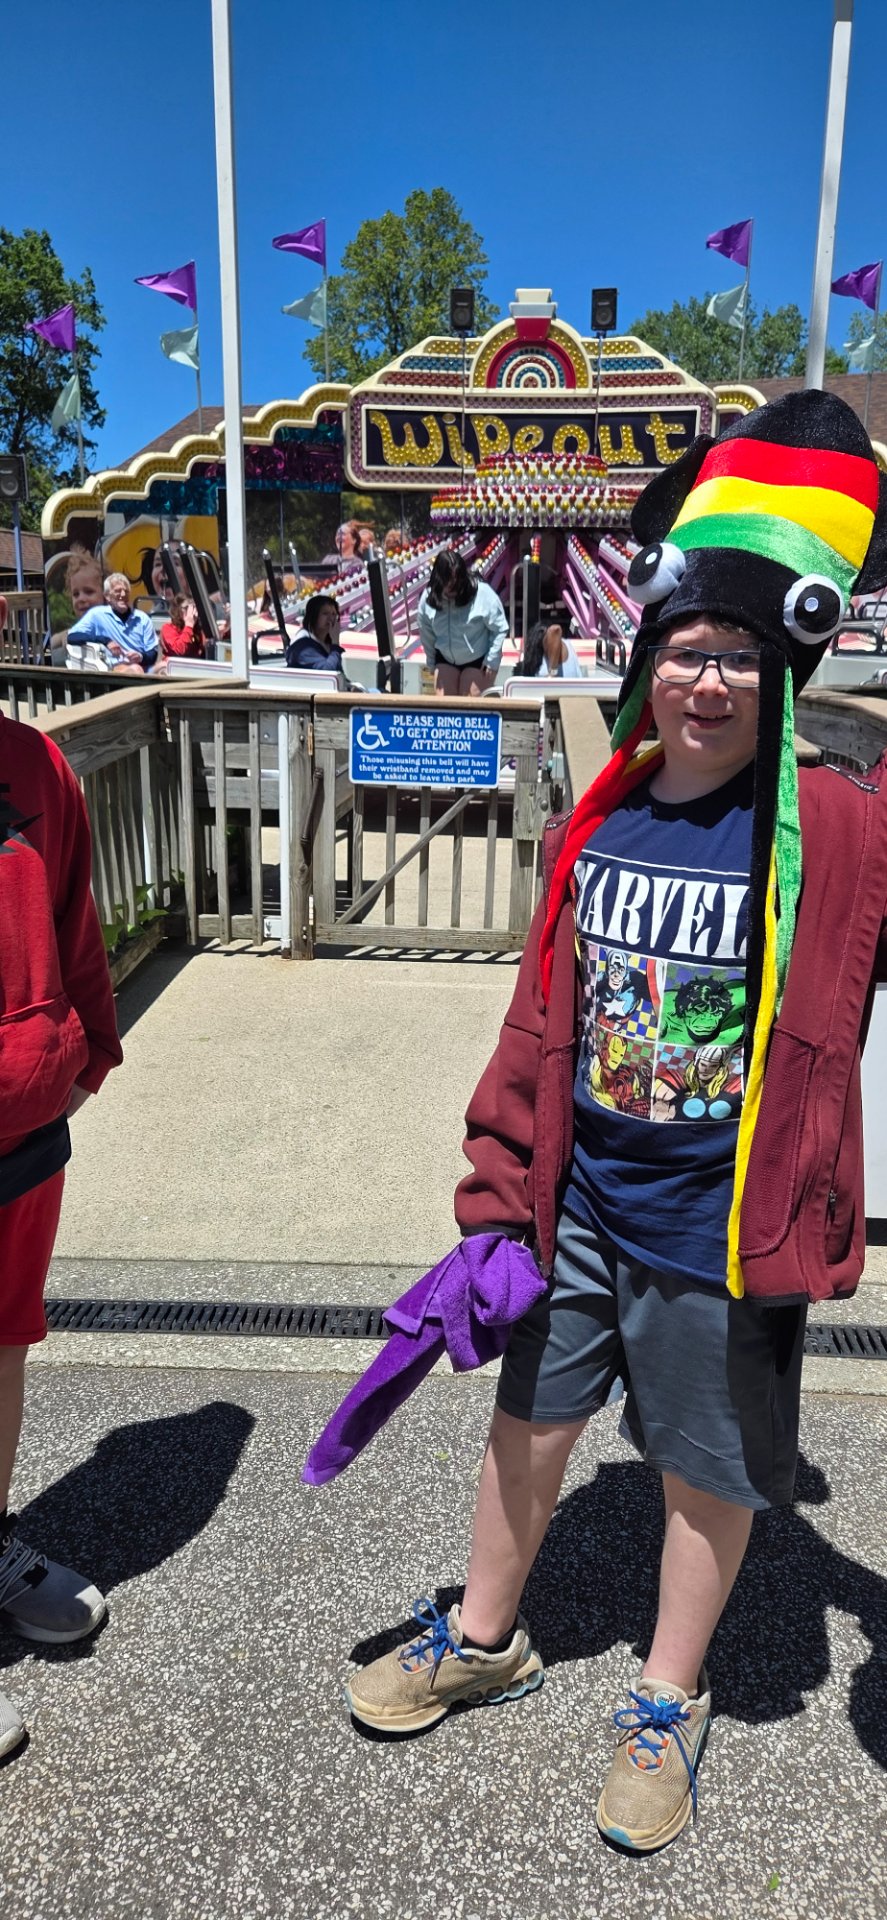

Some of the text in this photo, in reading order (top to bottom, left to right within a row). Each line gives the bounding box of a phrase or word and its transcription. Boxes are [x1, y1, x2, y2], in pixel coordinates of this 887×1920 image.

[393, 715, 491, 729] PLEASE RING BELL
[389, 727, 495, 741] TO GET OPERATORS
[411, 739, 471, 752] ATTENTION
[360, 754, 490, 767] Those misusing this bell will have
[359, 764, 491, 778] their wristband removed and may
[373, 772, 382, 780] be
[420, 774, 440, 782] leave
[457, 776, 476, 784] park
